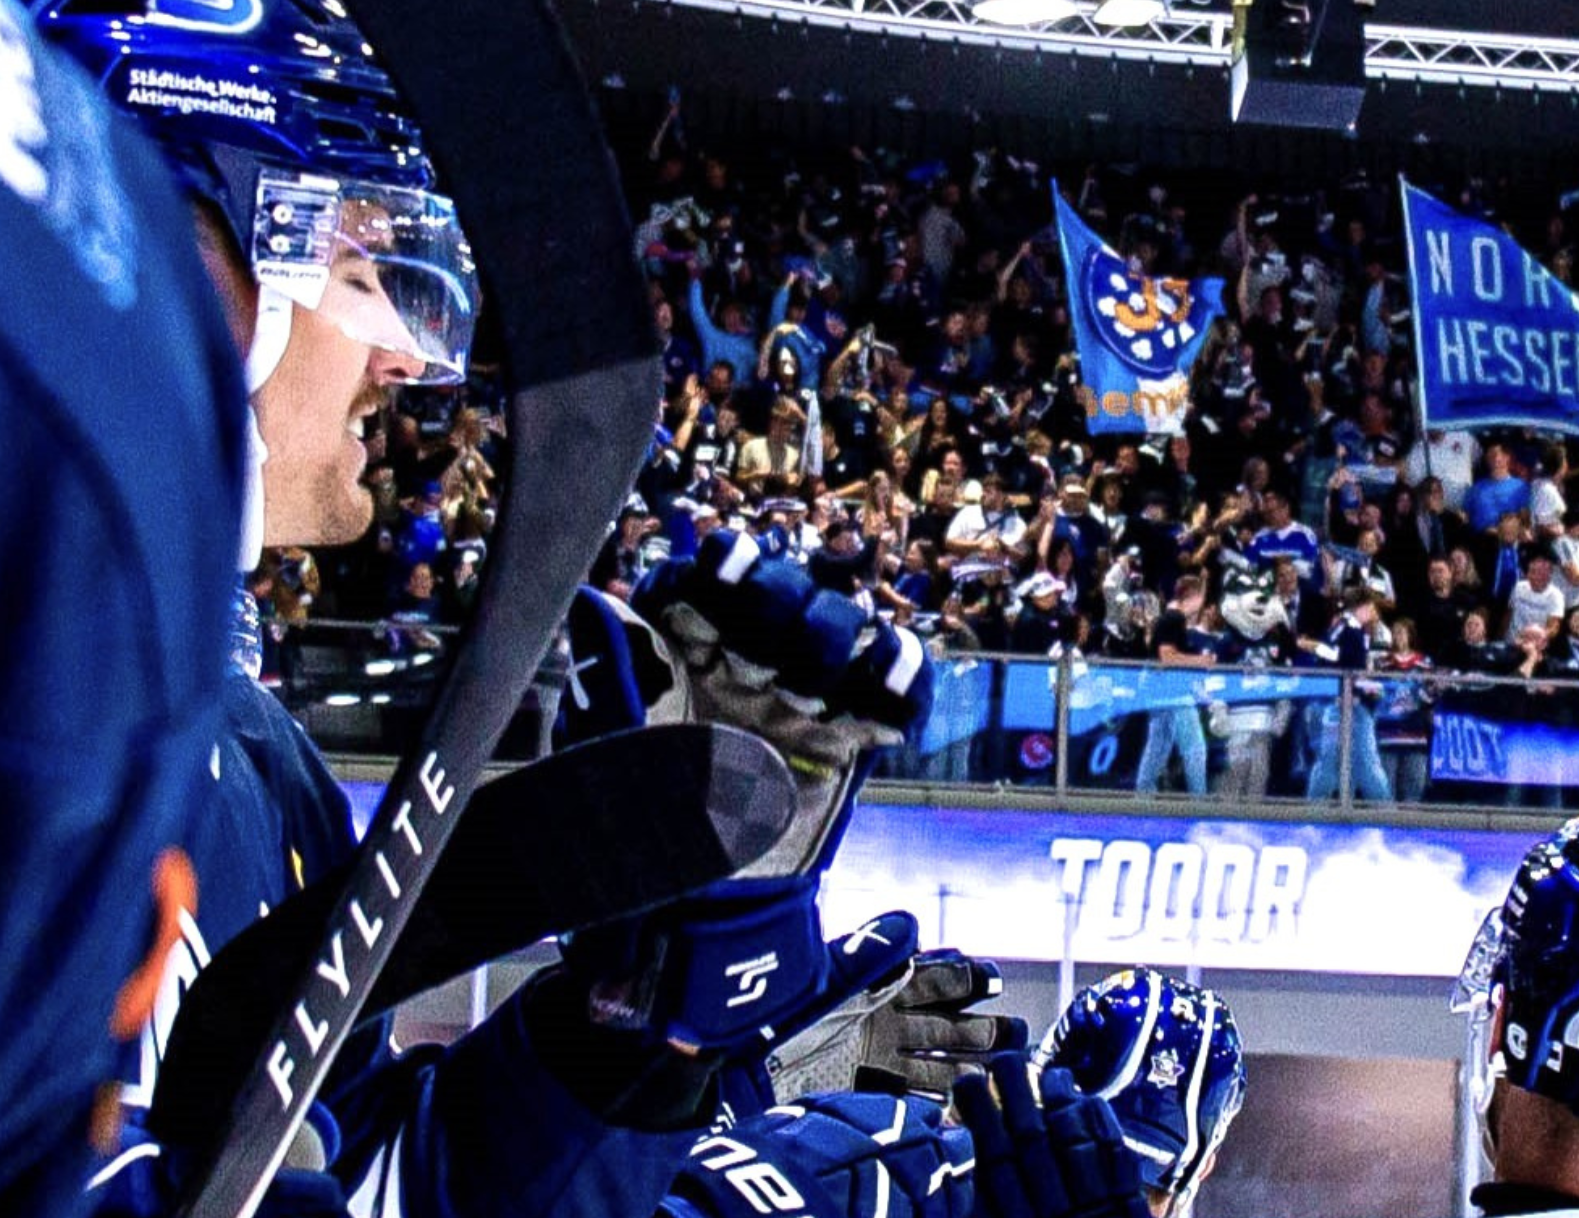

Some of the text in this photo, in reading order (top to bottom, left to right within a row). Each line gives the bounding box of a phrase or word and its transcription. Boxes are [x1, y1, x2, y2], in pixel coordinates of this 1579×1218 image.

[129, 68, 218, 97] Städtische
[127, 88, 277, 124] Aktiengesellschaft
[266, 750, 455, 1112] FLYLITE
